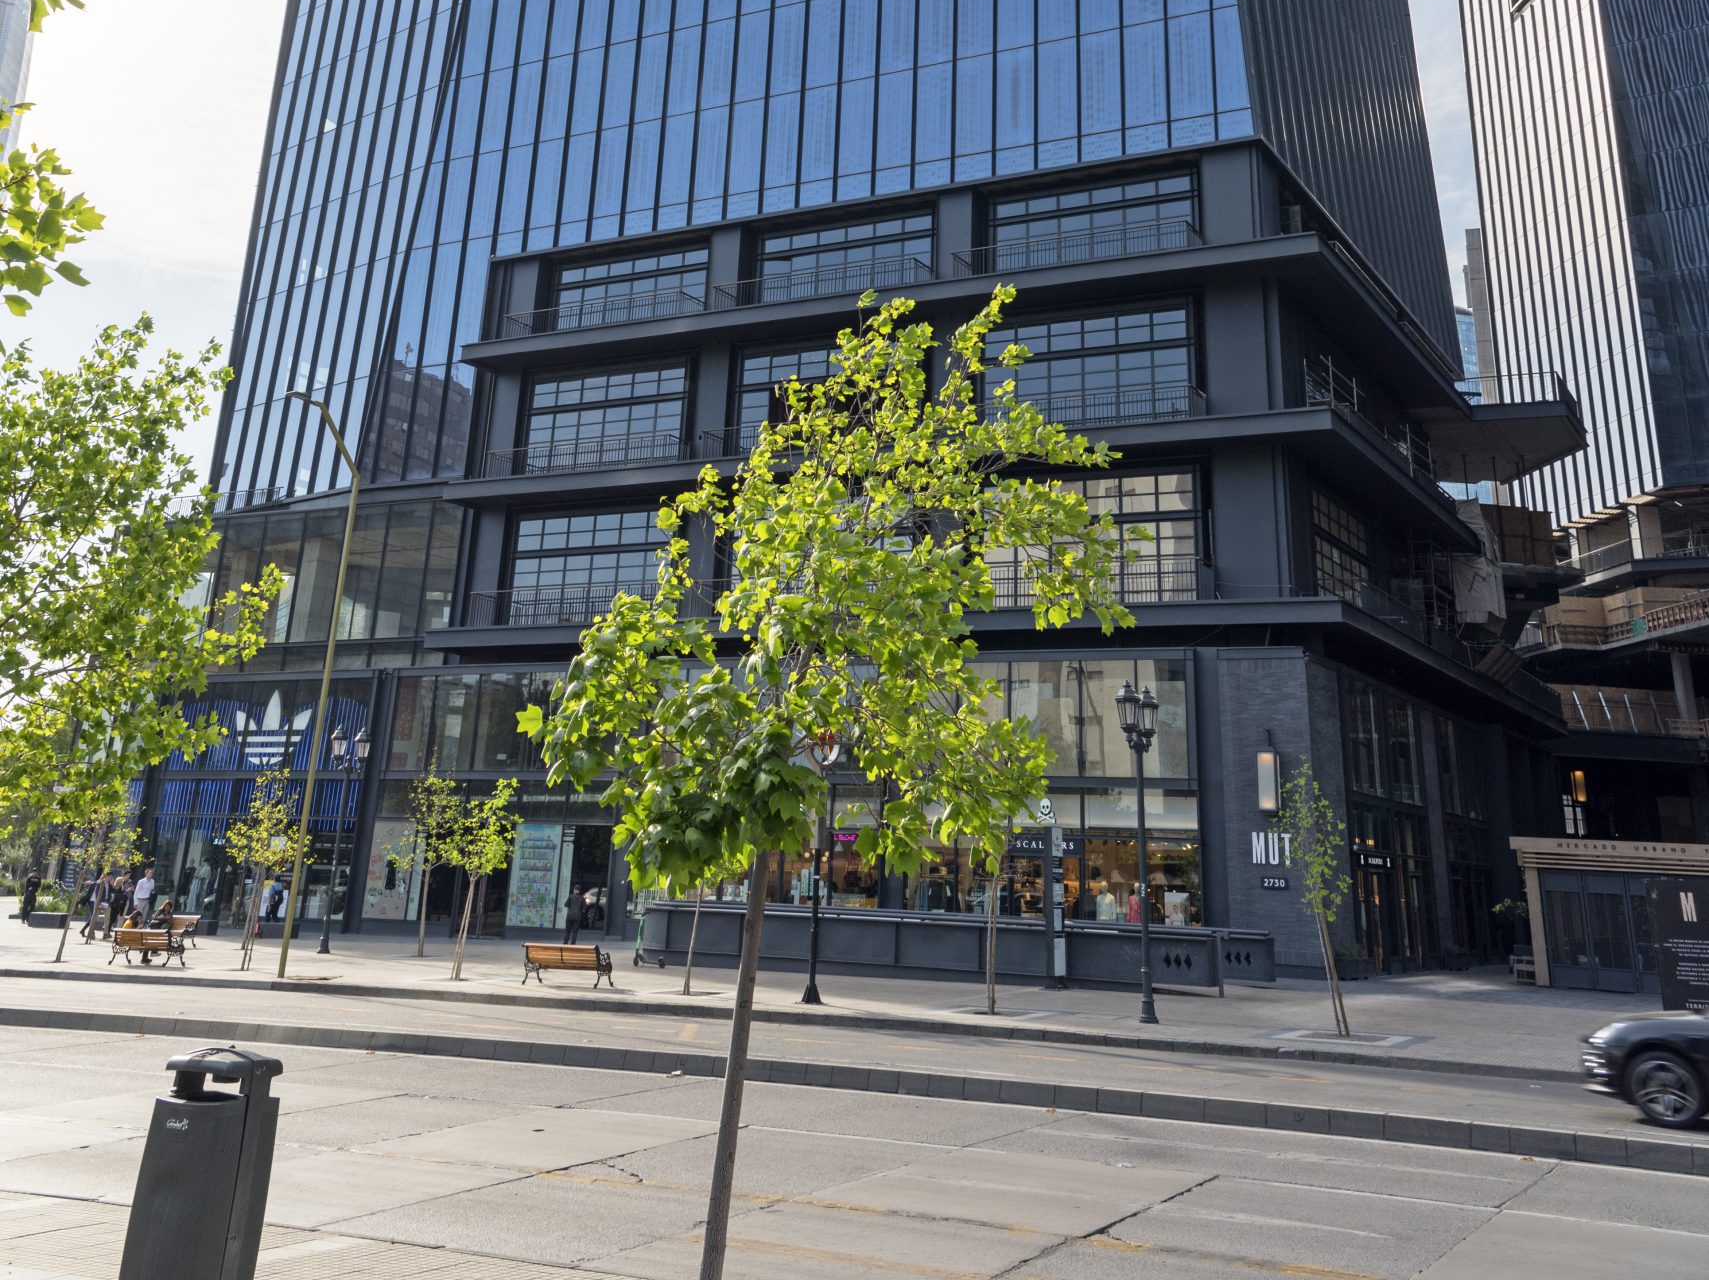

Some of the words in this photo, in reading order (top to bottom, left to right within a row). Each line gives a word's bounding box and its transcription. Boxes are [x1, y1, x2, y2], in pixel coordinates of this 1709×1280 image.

[1016, 840, 1074, 850] SCALRS
[1251, 831, 1292, 866] MUT
[1557, 842, 1617, 851] MERCADO
[1634, 845, 1687, 854] URBANO
[1263, 878, 1285, 888] 2730
[1680, 891, 1697, 922] M
